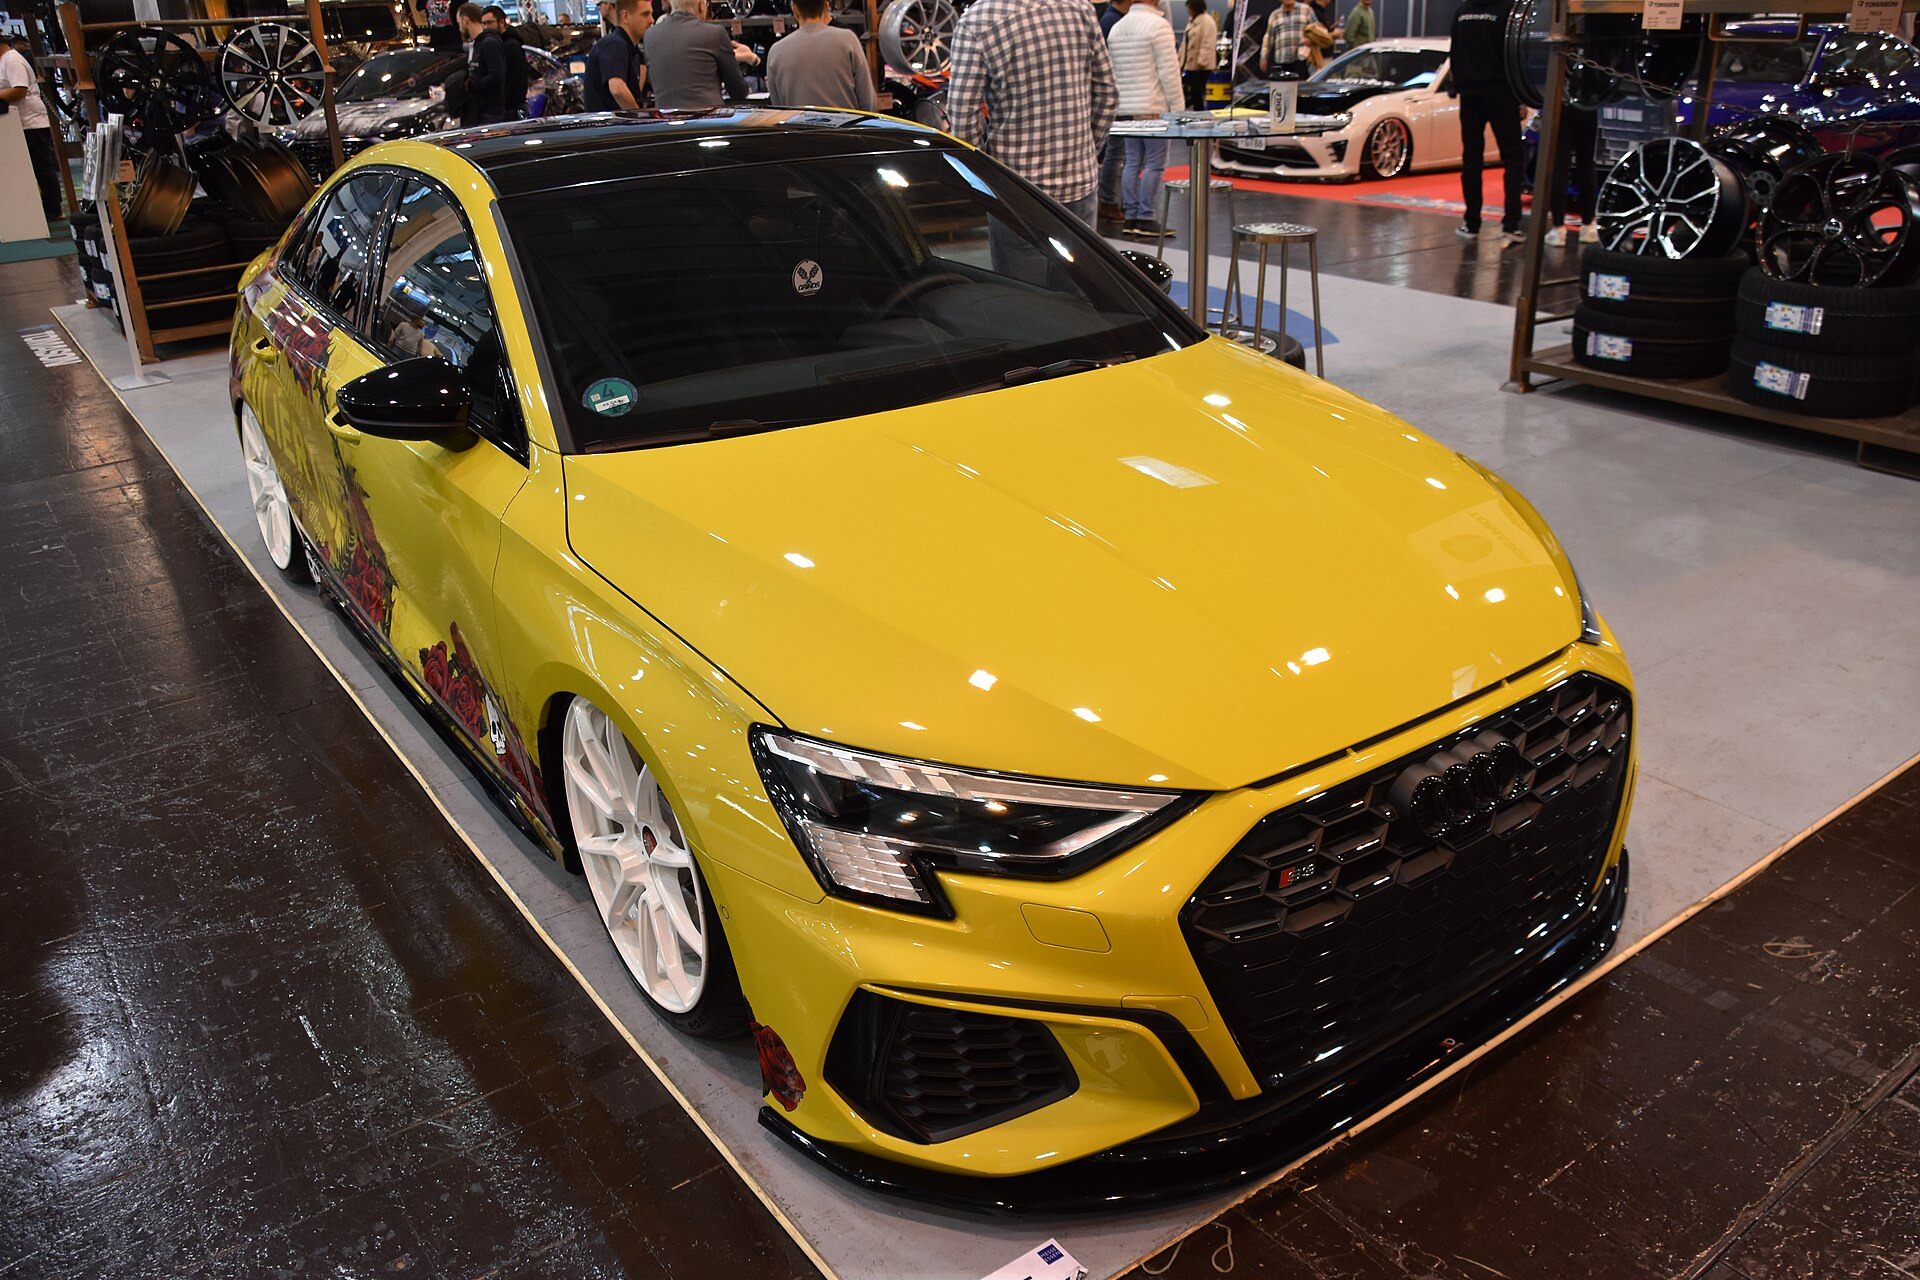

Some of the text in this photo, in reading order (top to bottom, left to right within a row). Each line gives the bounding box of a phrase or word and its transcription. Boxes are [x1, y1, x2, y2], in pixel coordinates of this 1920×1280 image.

[21, 330, 82, 368] TOMASON
[602, 383, 616, 397] 4
[1040, 1246, 1056, 1258] MESSE
[1044, 1250, 1061, 1262] ESSEN
